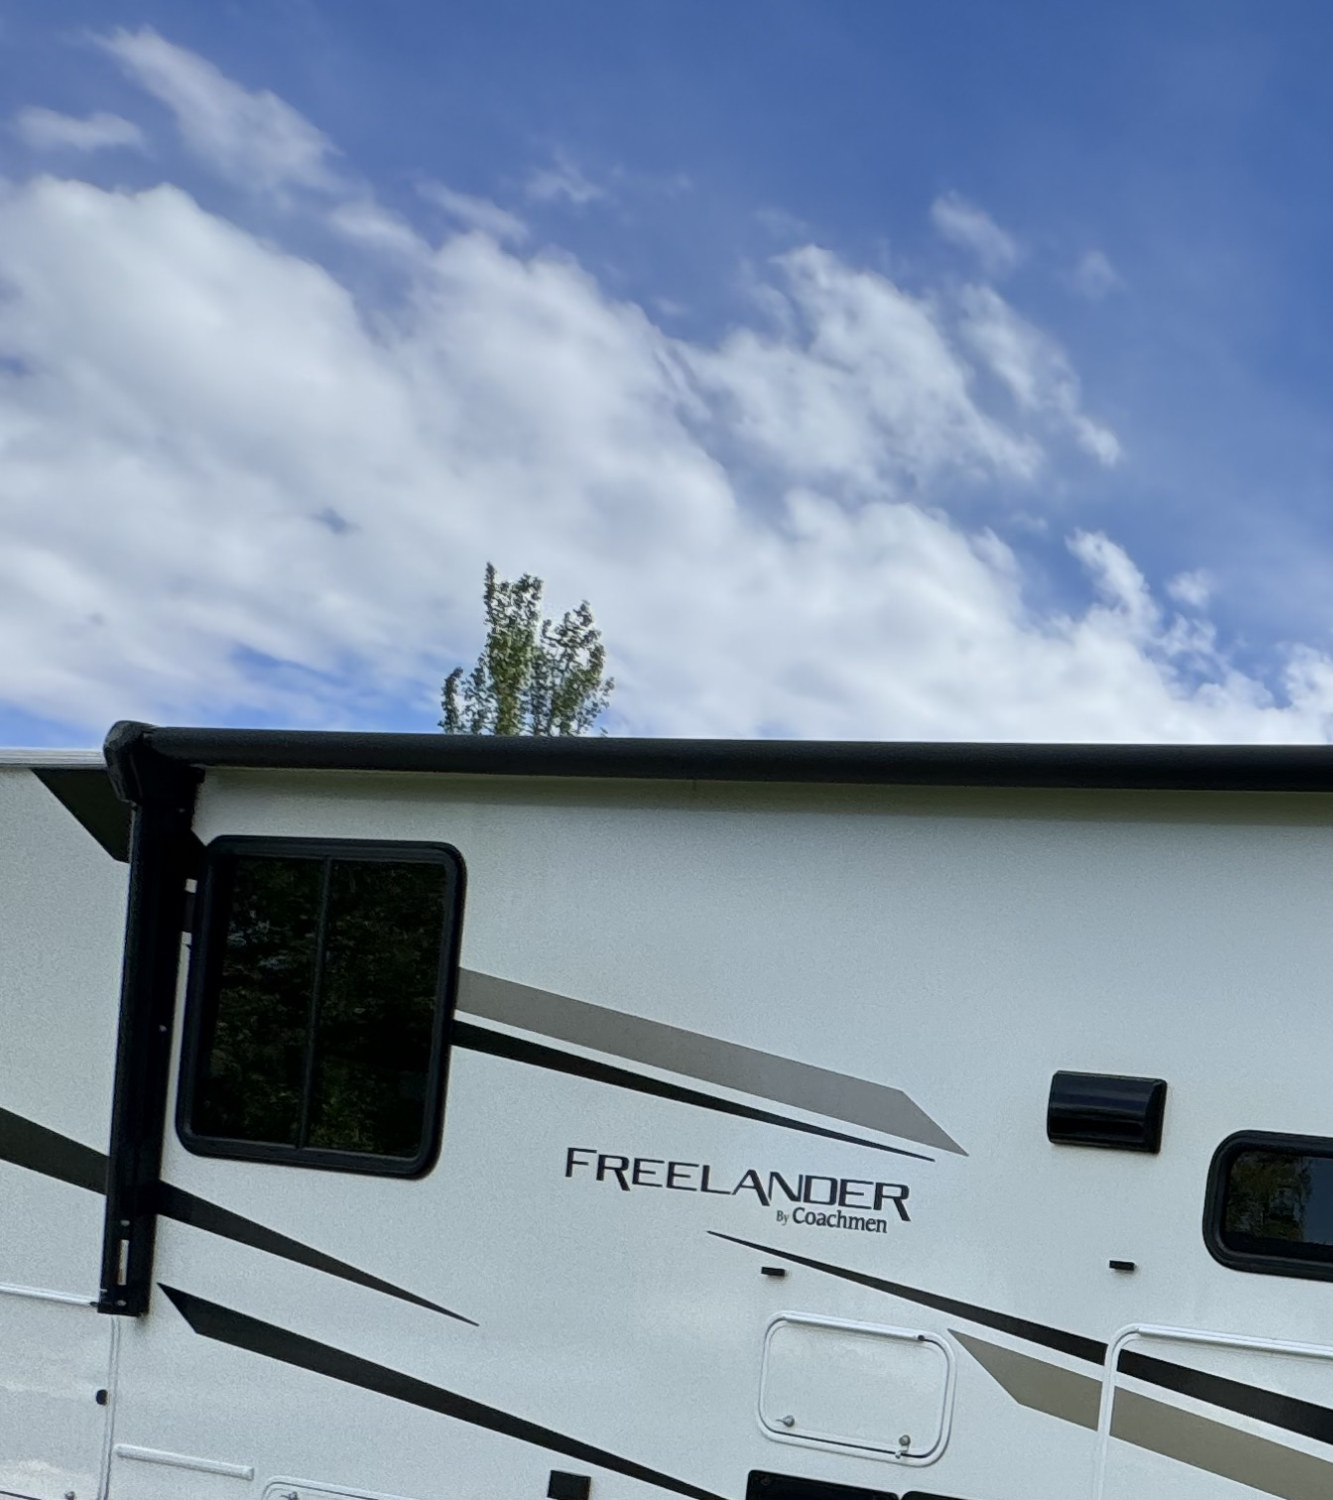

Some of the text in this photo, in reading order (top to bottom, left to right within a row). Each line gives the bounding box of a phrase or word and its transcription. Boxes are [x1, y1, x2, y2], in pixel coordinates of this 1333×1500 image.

[565, 1147, 911, 1222] FREELANDER
[776, 1207, 888, 1234] By Coachmen
